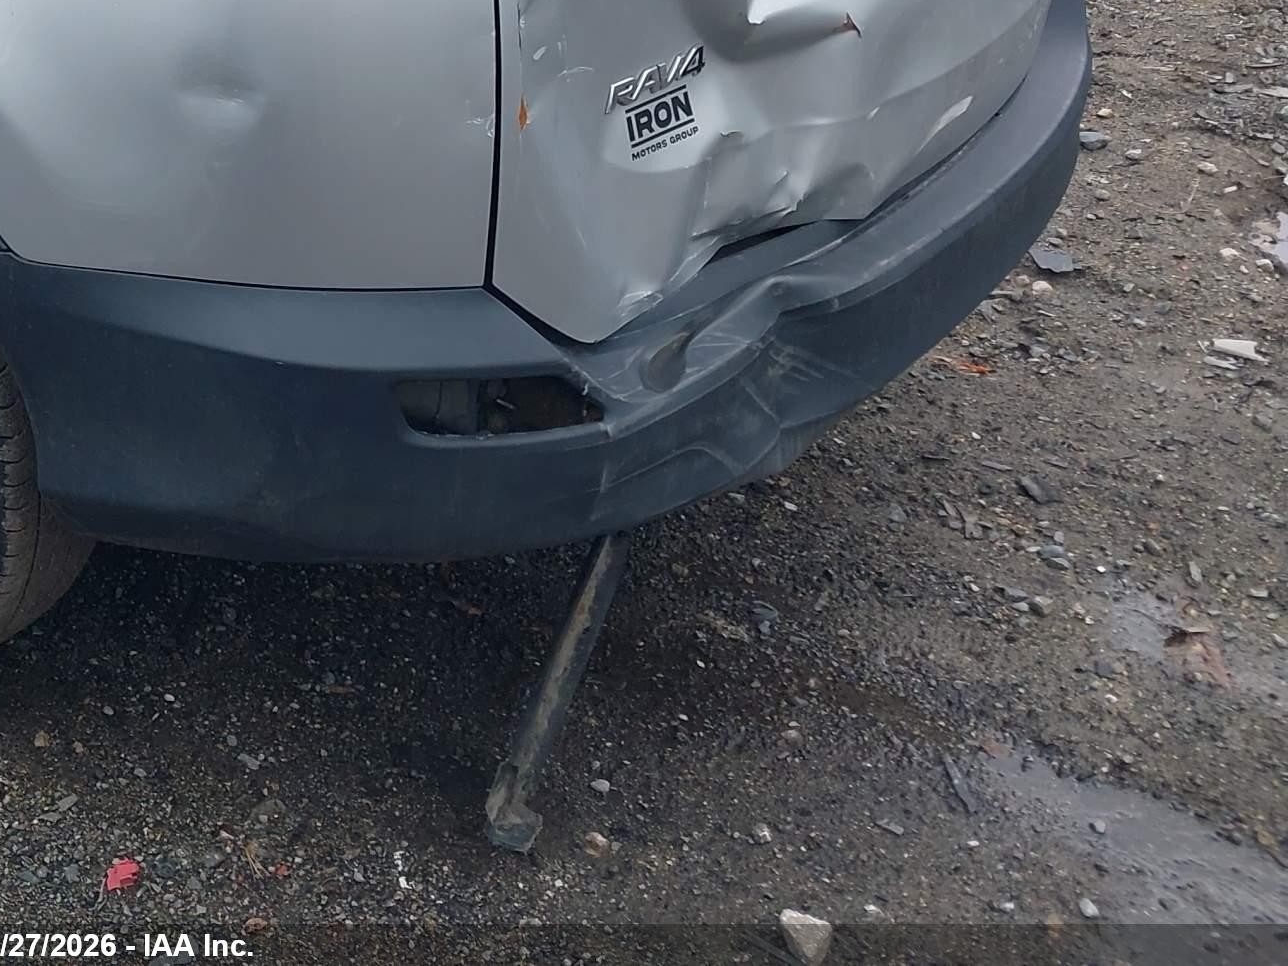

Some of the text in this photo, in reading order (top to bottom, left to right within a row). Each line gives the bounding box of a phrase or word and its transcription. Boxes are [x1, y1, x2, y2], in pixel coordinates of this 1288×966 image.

[604, 44, 706, 115] RAV4
[626, 91, 694, 142] IRON
[631, 126, 700, 161] MOTORS GROUP
